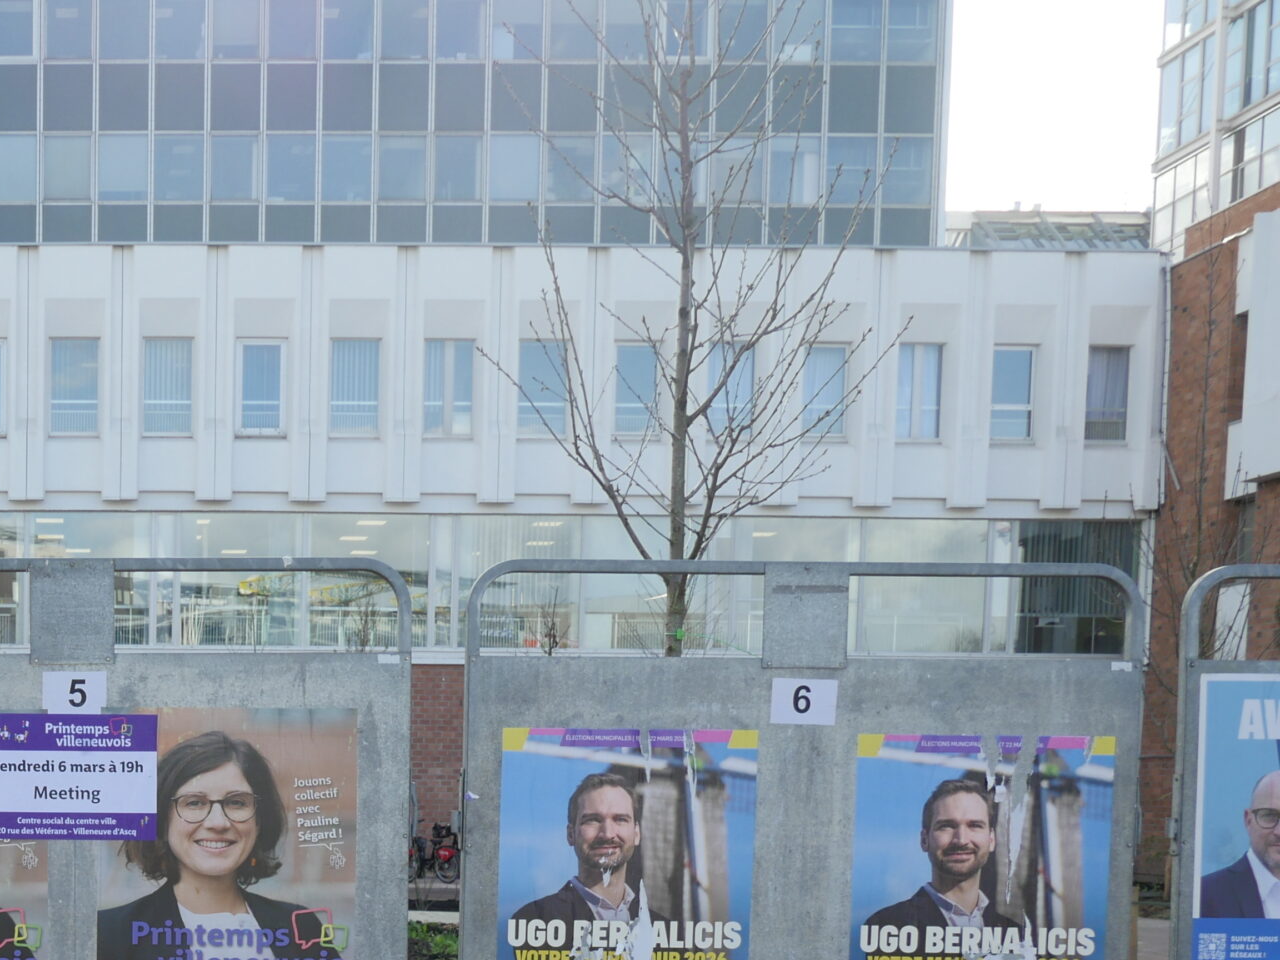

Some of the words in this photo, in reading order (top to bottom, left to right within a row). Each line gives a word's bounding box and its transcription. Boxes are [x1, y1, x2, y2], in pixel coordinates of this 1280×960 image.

[68, 679, 87, 707] 5
[792, 684, 812, 714] 6
[45, 722, 110, 736] Printemps
[56, 735, 132, 748] villeneuvois
[58, 760, 67, 773] 6
[70, 763, 105, 773] mars
[108, 761, 117, 773] à
[121, 761, 144, 773] 19h
[293, 777, 332, 787] Jouons
[33, 786, 101, 804] Meeting
[294, 787, 338, 801] collectif
[296, 805, 321, 814] avec
[17, 816, 41, 825] Centre
[42, 816, 64, 825] social
[65, 817, 75, 825] du
[100, 817, 117, 825] ville
[297, 816, 340, 828] Pauline
[21, 827, 34, 835] des
[34, 827, 67, 835] Vétérans
[112, 828, 137, 837] d'Ascq
[298, 828, 337, 842] Ségard
[131, 919, 290, 953] Printemps
[507, 918, 567, 948] UGO
[573, 919, 743, 950] BERALICIS
[859, 924, 919, 954] UGO
[925, 925, 1096, 957] BERNAICIS
[1230, 935, 1279, 943] SUIVEZ-NOUS
[1230, 943, 1245, 951] SUR
